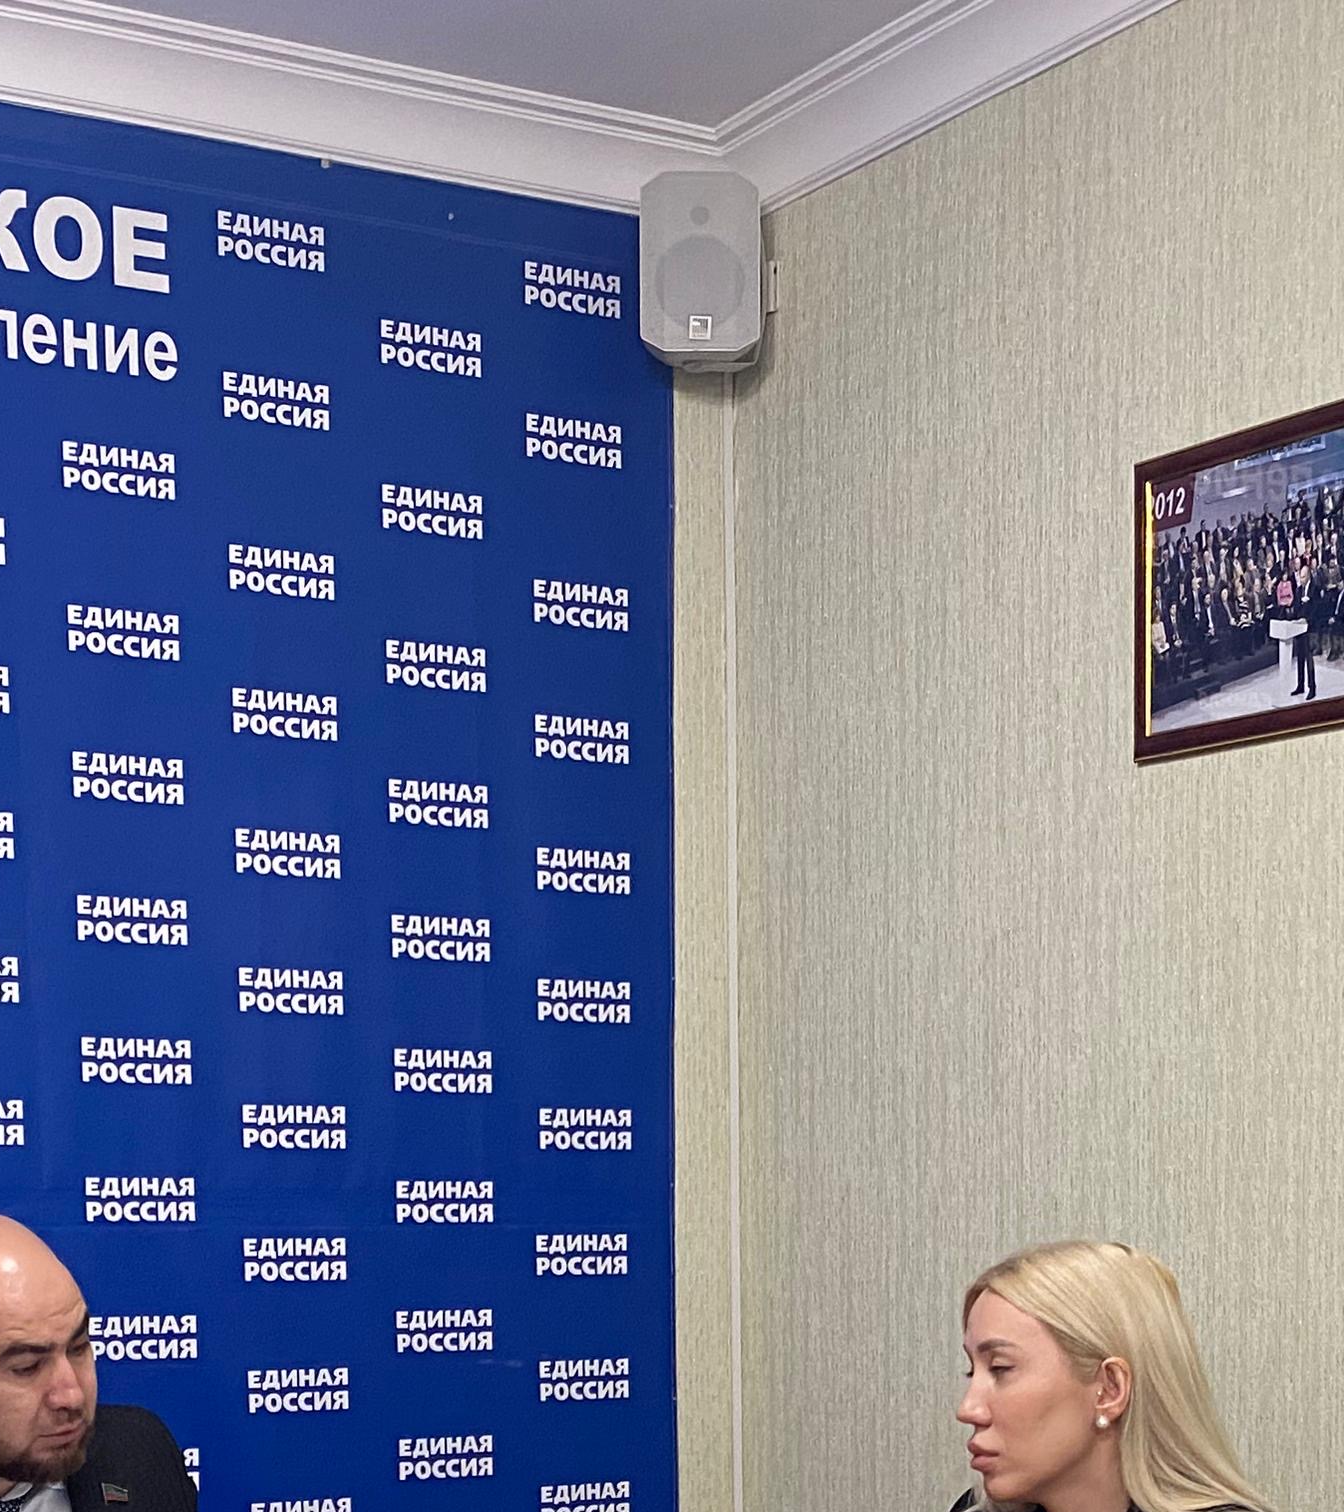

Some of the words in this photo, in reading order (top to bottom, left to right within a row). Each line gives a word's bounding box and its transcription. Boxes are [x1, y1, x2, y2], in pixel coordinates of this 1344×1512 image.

[218, 210, 324, 246] ЕДИНАЯ
[218, 236, 324, 271] РОССИЯ
[525, 261, 620, 294] ЕДИНАЯ
[525, 285, 620, 319] РОССИЯ
[381, 320, 481, 352] ЕДИНАЯ
[381, 344, 481, 377] РОССИЯ
[527, 413, 621, 444] ЕДИНАЯ
[63, 441, 174, 473] ЕДИНАЯ
[527, 437, 621, 468] РОССИЯ
[63, 467, 175, 500] РОССИЯ
[382, 484, 482, 514] ЕДИНАЯ
[1152, 487, 1186, 520] 012
[383, 509, 482, 539] РОССИЯ
[229, 544, 334, 574] ЕДИНАЯ
[230, 569, 334, 600] РОССИЯ
[534, 579, 628, 606] ЕДИНАЯ
[68, 605, 178, 634] ЕДИНАЯ
[534, 603, 628, 631] РОССИЯ
[68, 630, 179, 661] РОССИЯ
[386, 640, 485, 667] ЕДИНАЯ
[387, 664, 486, 692] РОССИЯ
[233, 688, 337, 715] ЕДИНАЯ
[233, 712, 337, 741] РОССИЯ
[535, 715, 628, 740] ЕДИНАЯ
[535, 738, 629, 764] РОССИЯ
[73, 751, 183, 778] ЕДИНАЯ
[73, 777, 184, 804] РОССИЯ
[389, 779, 487, 804] ЕДИНАЯ
[389, 803, 488, 828] РОССИЯ
[537, 848, 630, 870] ЕДИНАЯ
[537, 871, 630, 894] РОССИЯ
[77, 895, 187, 919] ЕДИНАЯ
[78, 920, 187, 945] РОССИЯ
[239, 968, 343, 989] ЕДИНАЯ
[538, 979, 630, 999] ЕДИНАЯ
[240, 992, 343, 1015] РОССИЯ
[538, 1002, 630, 1023] РОССИЯ
[81, 1037, 191, 1059] ЕДИНАЯ
[394, 1049, 491, 1069] ЕДИНАЯ
[82, 1062, 192, 1084] РОССИЯ
[395, 1072, 492, 1093] РОССИЯ
[243, 1105, 345, 1125] ЕДИНАЯ
[540, 1109, 631, 1128] ЕДИНАЯ
[243, 1128, 346, 1149] РОССИЯ
[540, 1131, 631, 1149] РОССИЯ
[397, 1181, 493, 1201] ЕДИНАЯ
[397, 1203, 493, 1223] РОССИЯ
[244, 1238, 346, 1259] ЕДИНАЯ
[536, 1234, 627, 1254] ЕДИНАЯ
[245, 1261, 346, 1281] РОССИЯ
[537, 1256, 627, 1275] РОССИЯ
[88, 1315, 197, 1337] ЕДИНАЯ
[396, 1309, 492, 1330] ЕДИНАЯ
[397, 1332, 492, 1352] РОССИЯ
[540, 1358, 628, 1380] ЕДИНАЯ
[540, 1380, 629, 1401] РОССИЯ
[399, 1435, 492, 1458] ЕДИНАЯ
[400, 1457, 493, 1480] РОССИЯ
[541, 1481, 629, 1504] ЕДИНАЯ
